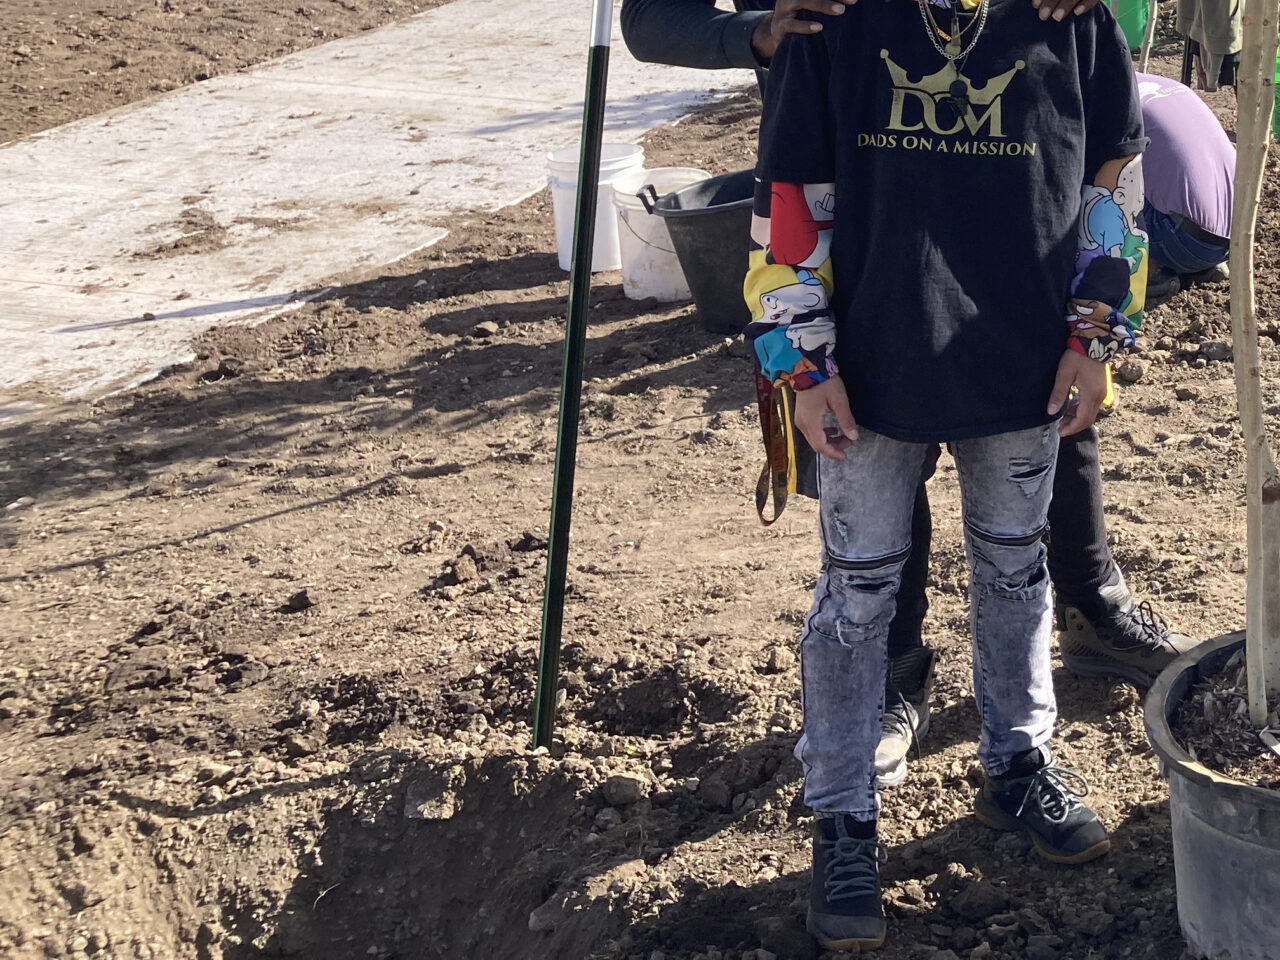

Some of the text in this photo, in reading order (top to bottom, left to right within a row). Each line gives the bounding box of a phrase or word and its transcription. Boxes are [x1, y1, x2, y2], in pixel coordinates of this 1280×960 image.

[884, 88, 1008, 138] DOM
[857, 133, 1037, 156] DADS ON A MISSION
